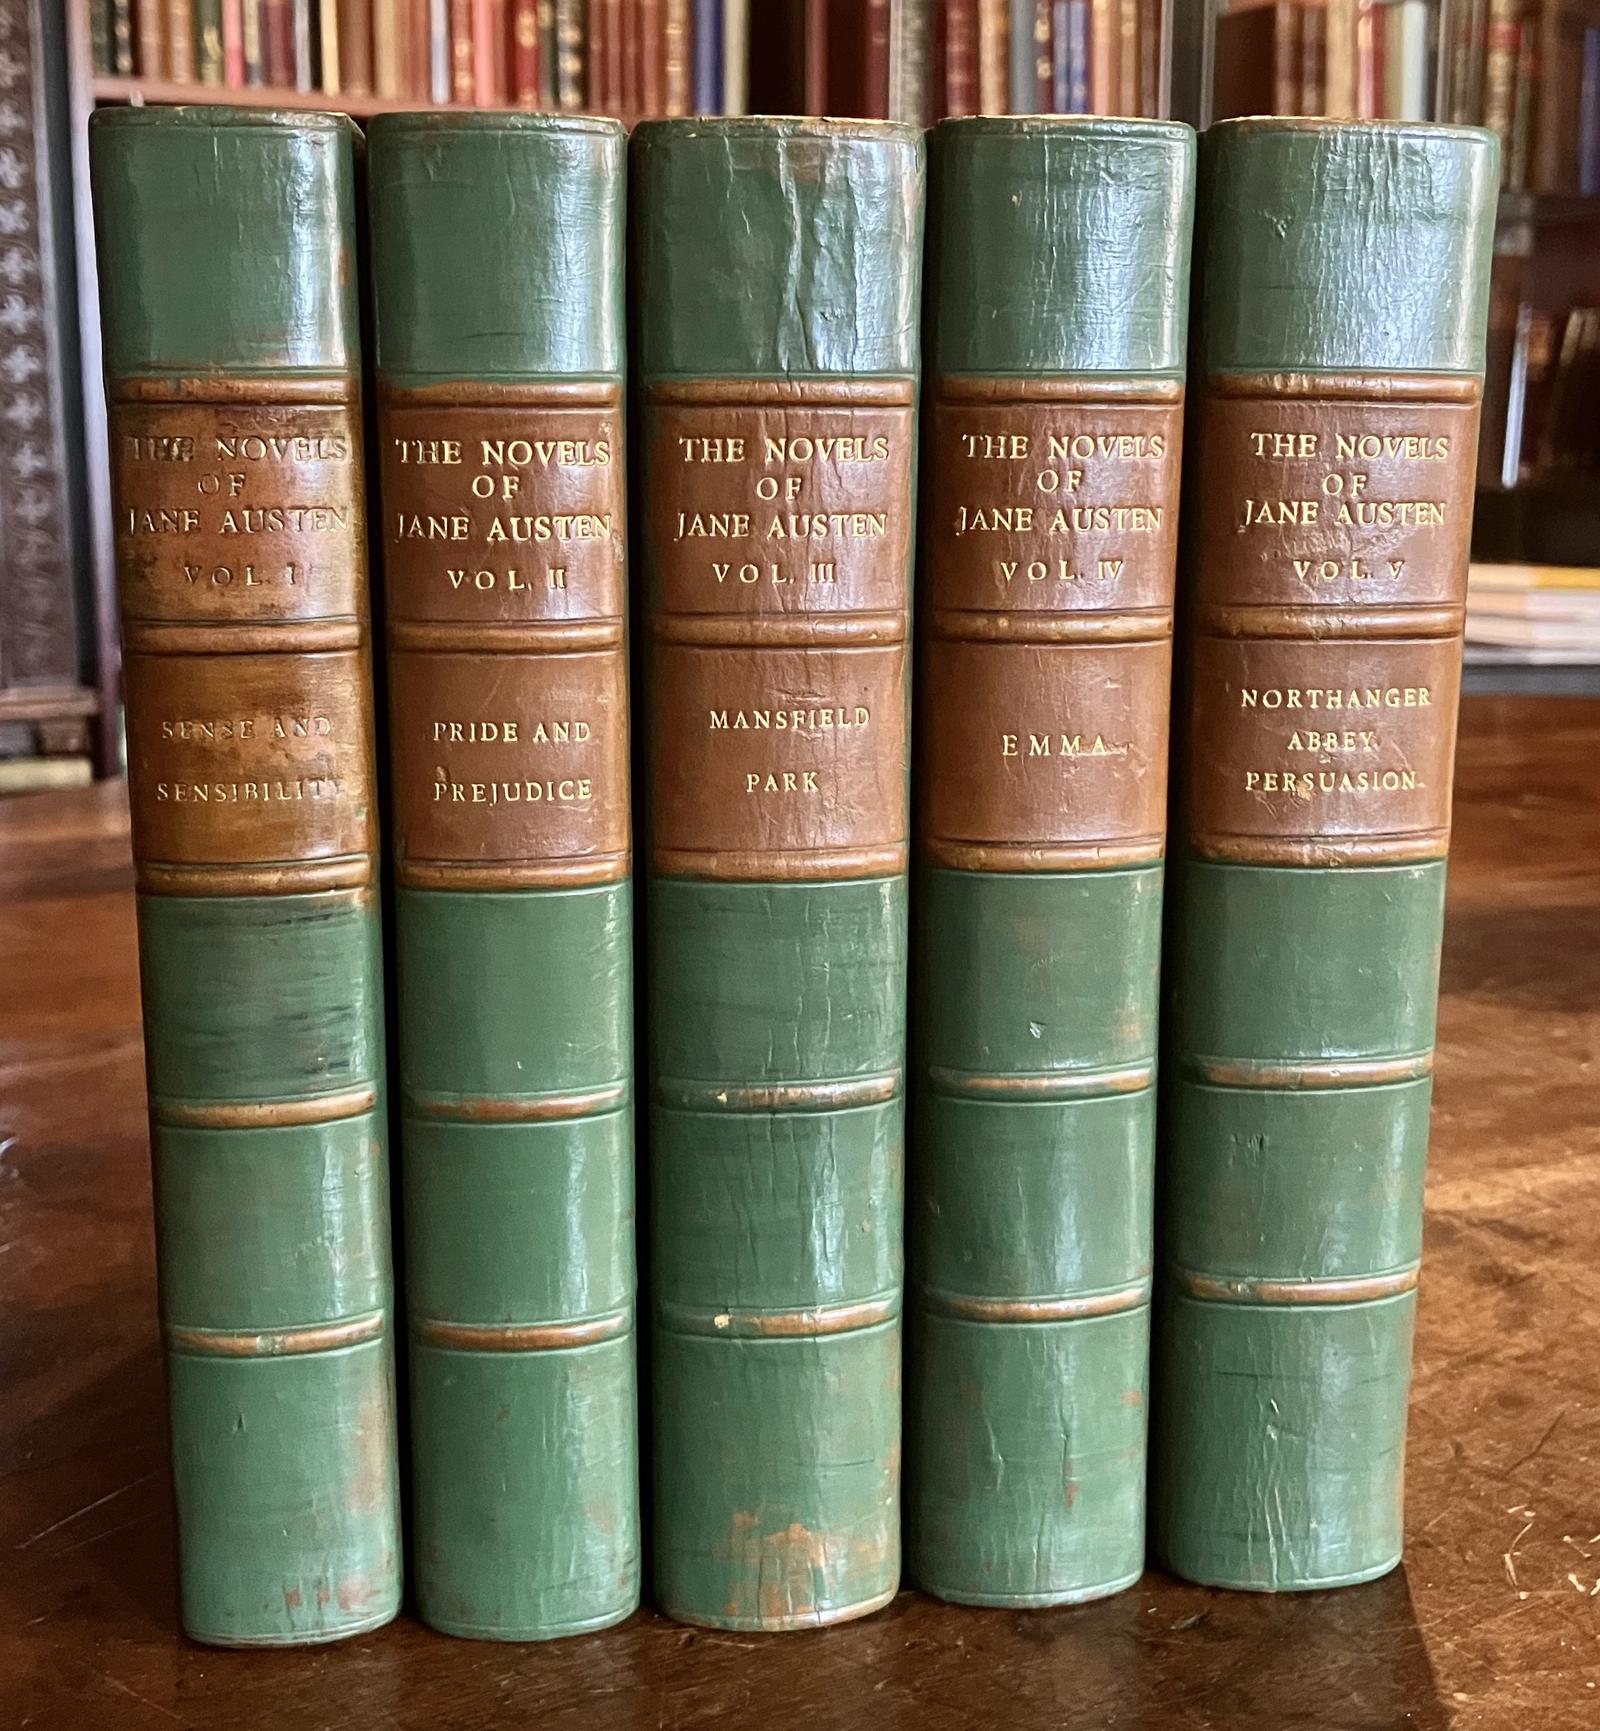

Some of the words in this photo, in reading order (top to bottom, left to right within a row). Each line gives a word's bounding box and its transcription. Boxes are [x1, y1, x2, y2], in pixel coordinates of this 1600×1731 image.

[128, 434, 195, 462] THE
[215, 435, 352, 464] NOVELS
[395, 438, 462, 464] THE
[480, 440, 610, 466] NOVELS
[679, 437, 745, 463] THE
[763, 437, 889, 463] NOVELS
[962, 434, 1029, 460] THE
[1049, 435, 1165, 461] NOVELS
[1251, 433, 1318, 458] THE
[1335, 434, 1449, 460] NOVELS
[197, 472, 246, 497] OF
[472, 475, 520, 500] OF
[756, 477, 802, 502] OF
[1037, 469, 1082, 495] OF
[1322, 473, 1367, 498] OF
[127, 507, 201, 536] JANE
[218, 506, 348, 534] AUSTEN
[395, 512, 470, 543] JANE
[487, 515, 611, 542] AUSTEN
[673, 512, 750, 542] JANE
[767, 513, 887, 541] AUSTEN
[955, 506, 1033, 536] JANE
[1050, 508, 1163, 534] AUSTEN
[1237, 499, 1319, 533] JANE
[1334, 502, 1446, 526] AUSTEN
[285, 562, 296, 586] I
[447, 569, 532, 591] VOL.
[549, 568, 567, 589] II
[712, 563, 796, 584] VOL.
[810, 563, 835, 584] III
[1097, 560, 1124, 580] IV
[1387, 559, 1405, 580] V
[1241, 687, 1432, 710] NORTHANGER
[162, 720, 255, 739] SENSE
[273, 716, 333, 738] AND
[709, 708, 871, 730] MANSFIELD
[433, 722, 518, 743] PRIDE
[532, 722, 592, 743] AND
[1287, 731, 1376, 753] ABBEY
[1002, 734, 1107, 757] EMMA
[433, 779, 593, 807] PREJUDICE
[746, 771, 819, 792] PARK
[1245, 770, 1416, 793] PERSUASION
